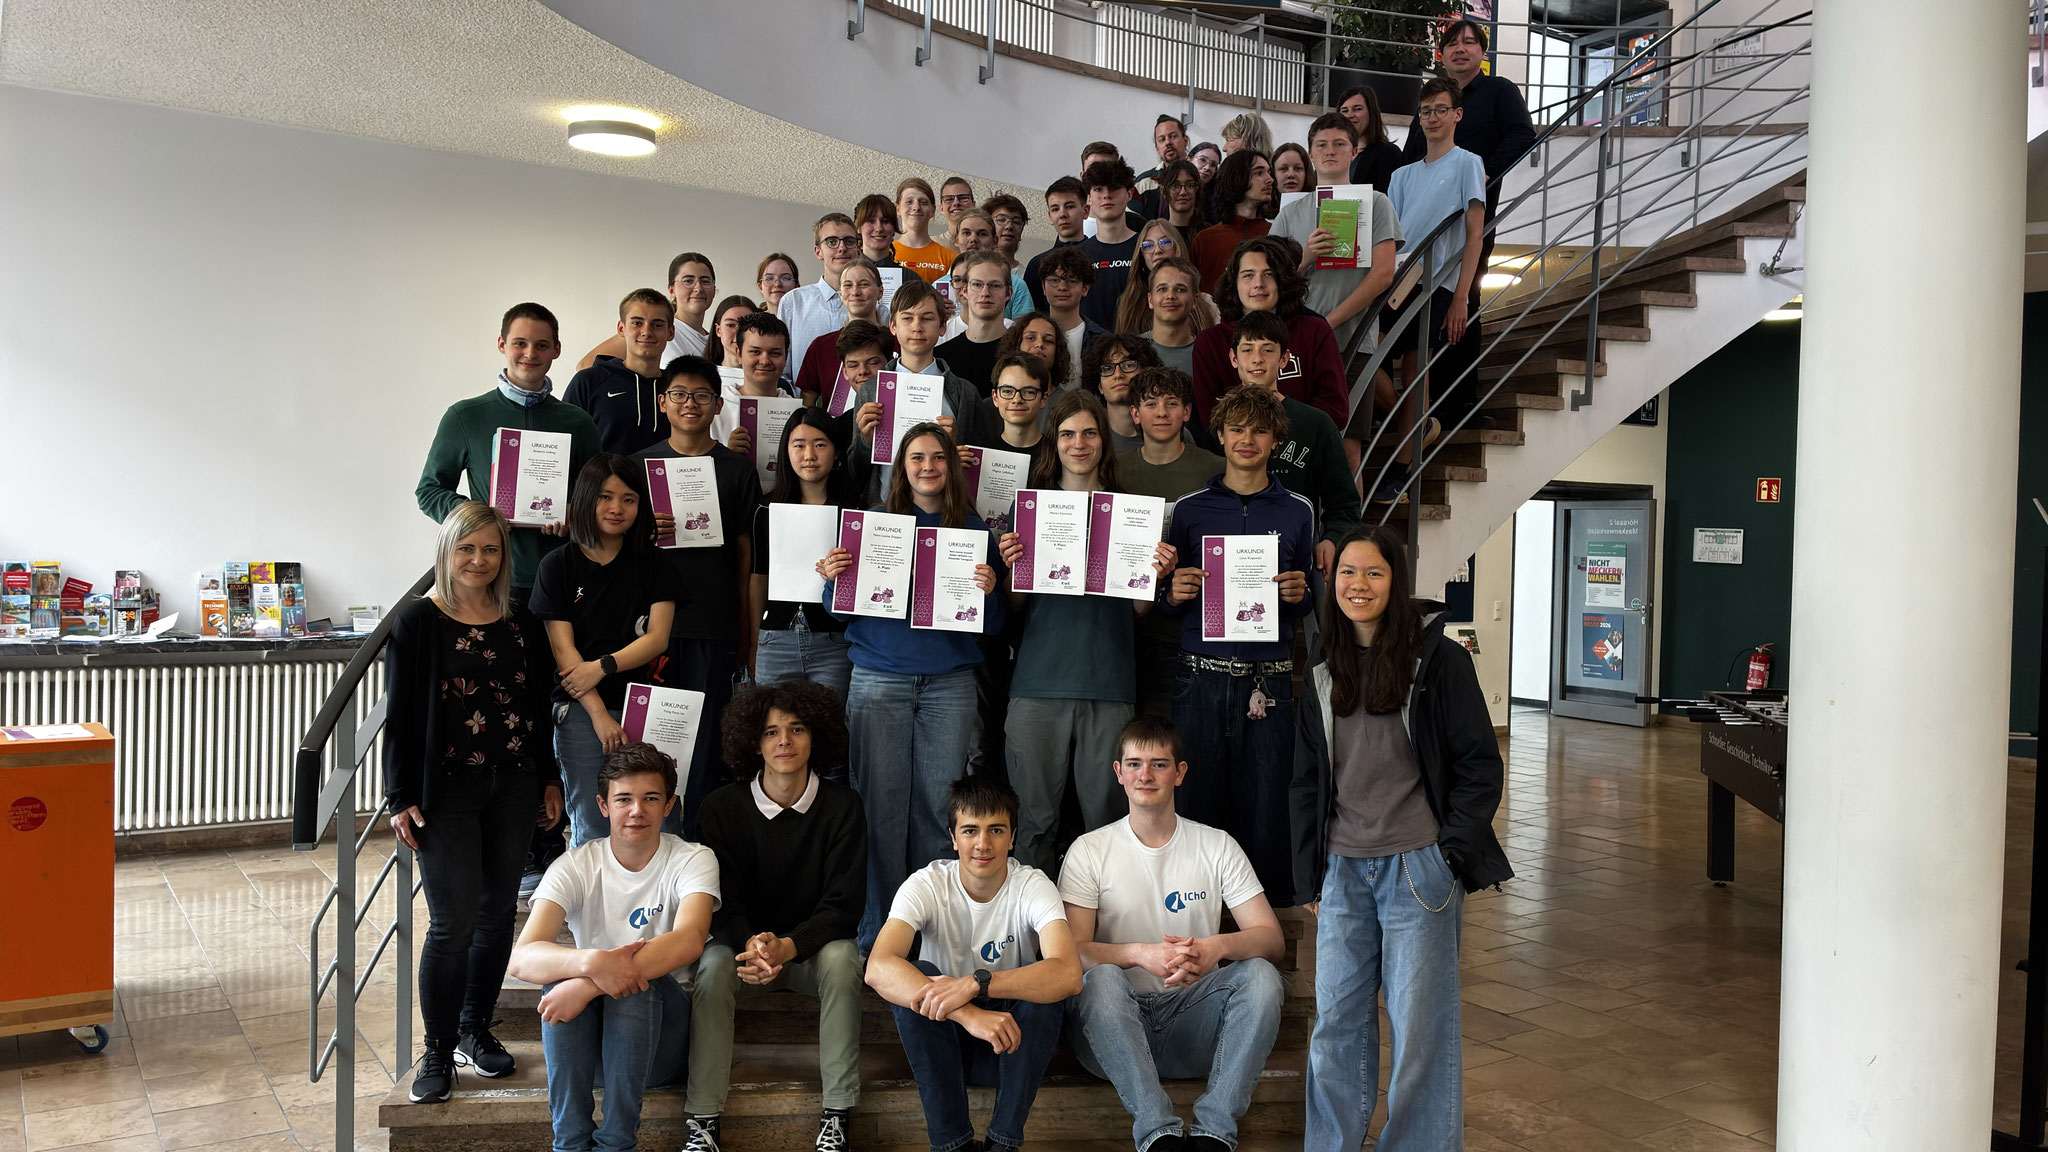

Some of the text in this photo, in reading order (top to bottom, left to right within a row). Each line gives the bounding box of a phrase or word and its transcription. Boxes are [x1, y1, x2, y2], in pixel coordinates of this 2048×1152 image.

[916, 262, 945, 271] JONES
[992, 462, 1016, 470] URKUNDE
[1588, 567, 1624, 576] MECKERN,
[662, 702, 690, 710] URKUNDE
